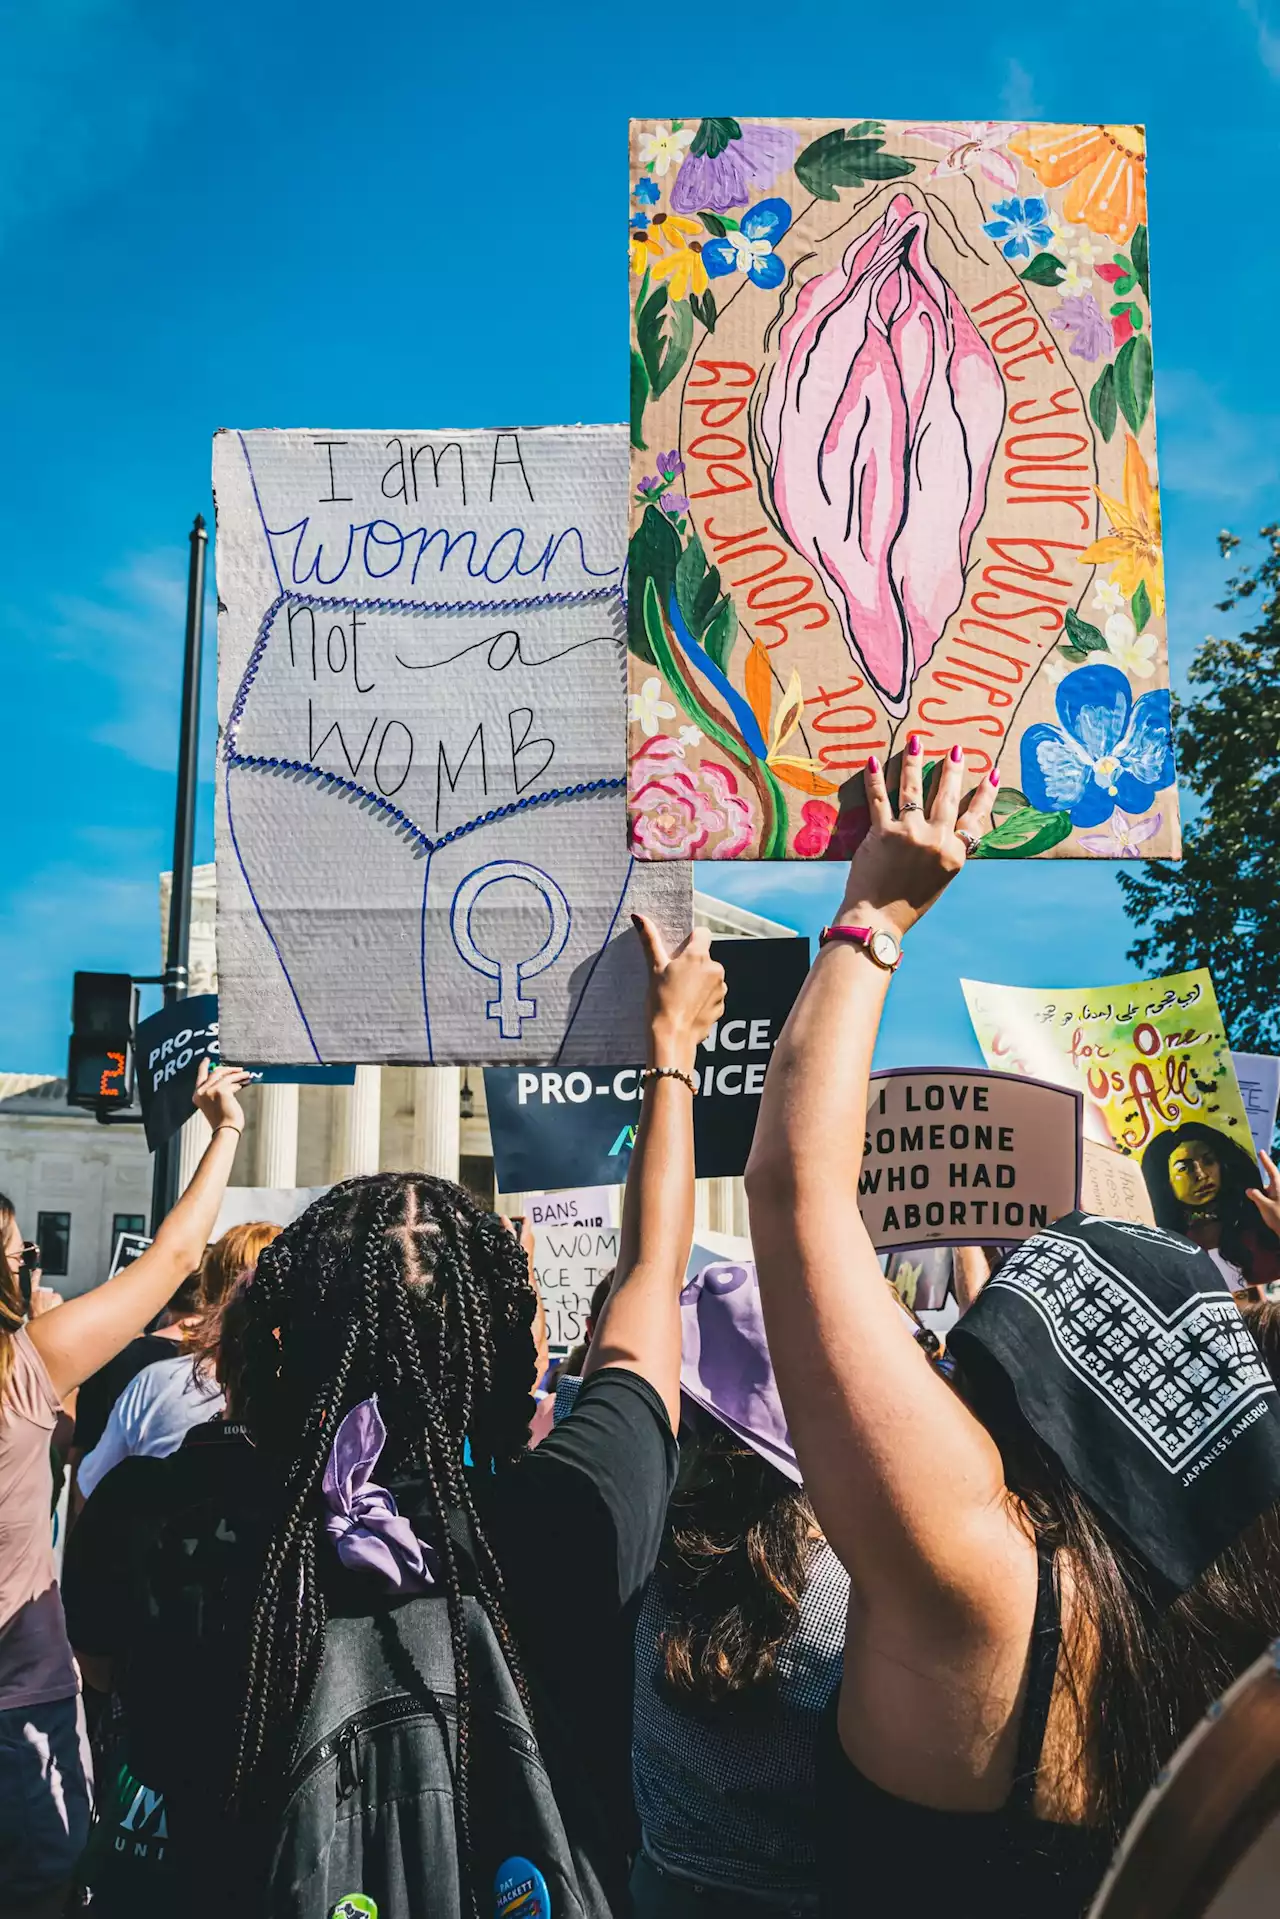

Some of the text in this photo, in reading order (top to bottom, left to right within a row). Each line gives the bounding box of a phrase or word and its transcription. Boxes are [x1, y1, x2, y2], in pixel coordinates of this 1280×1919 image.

[970, 284, 1055, 382] not
[685, 359, 758, 500] body
[313, 434, 534, 505] I am A
[1003, 386, 1092, 531] your
[265, 517, 621, 585] woman
[704, 516, 831, 651] your
[288, 606, 375, 692] not
[308, 698, 555, 832] WOMB
[148, 1022, 219, 1070] PRO-S
[153, 1040, 220, 1092] PRO-C
[879, 1085, 989, 1115] I LOVE
[1122, 1055, 1200, 1149] All
[858, 1163, 1016, 1195] WHO HAD
[532, 1200, 578, 1224] BANS
[882, 1201, 1047, 1232] ABORTION
[546, 1233, 617, 1258] WOM
[533, 1267, 571, 1289] ACE
[556, 1292, 592, 1311] th
[1182, 1436, 1233, 1488] JAPANESE
